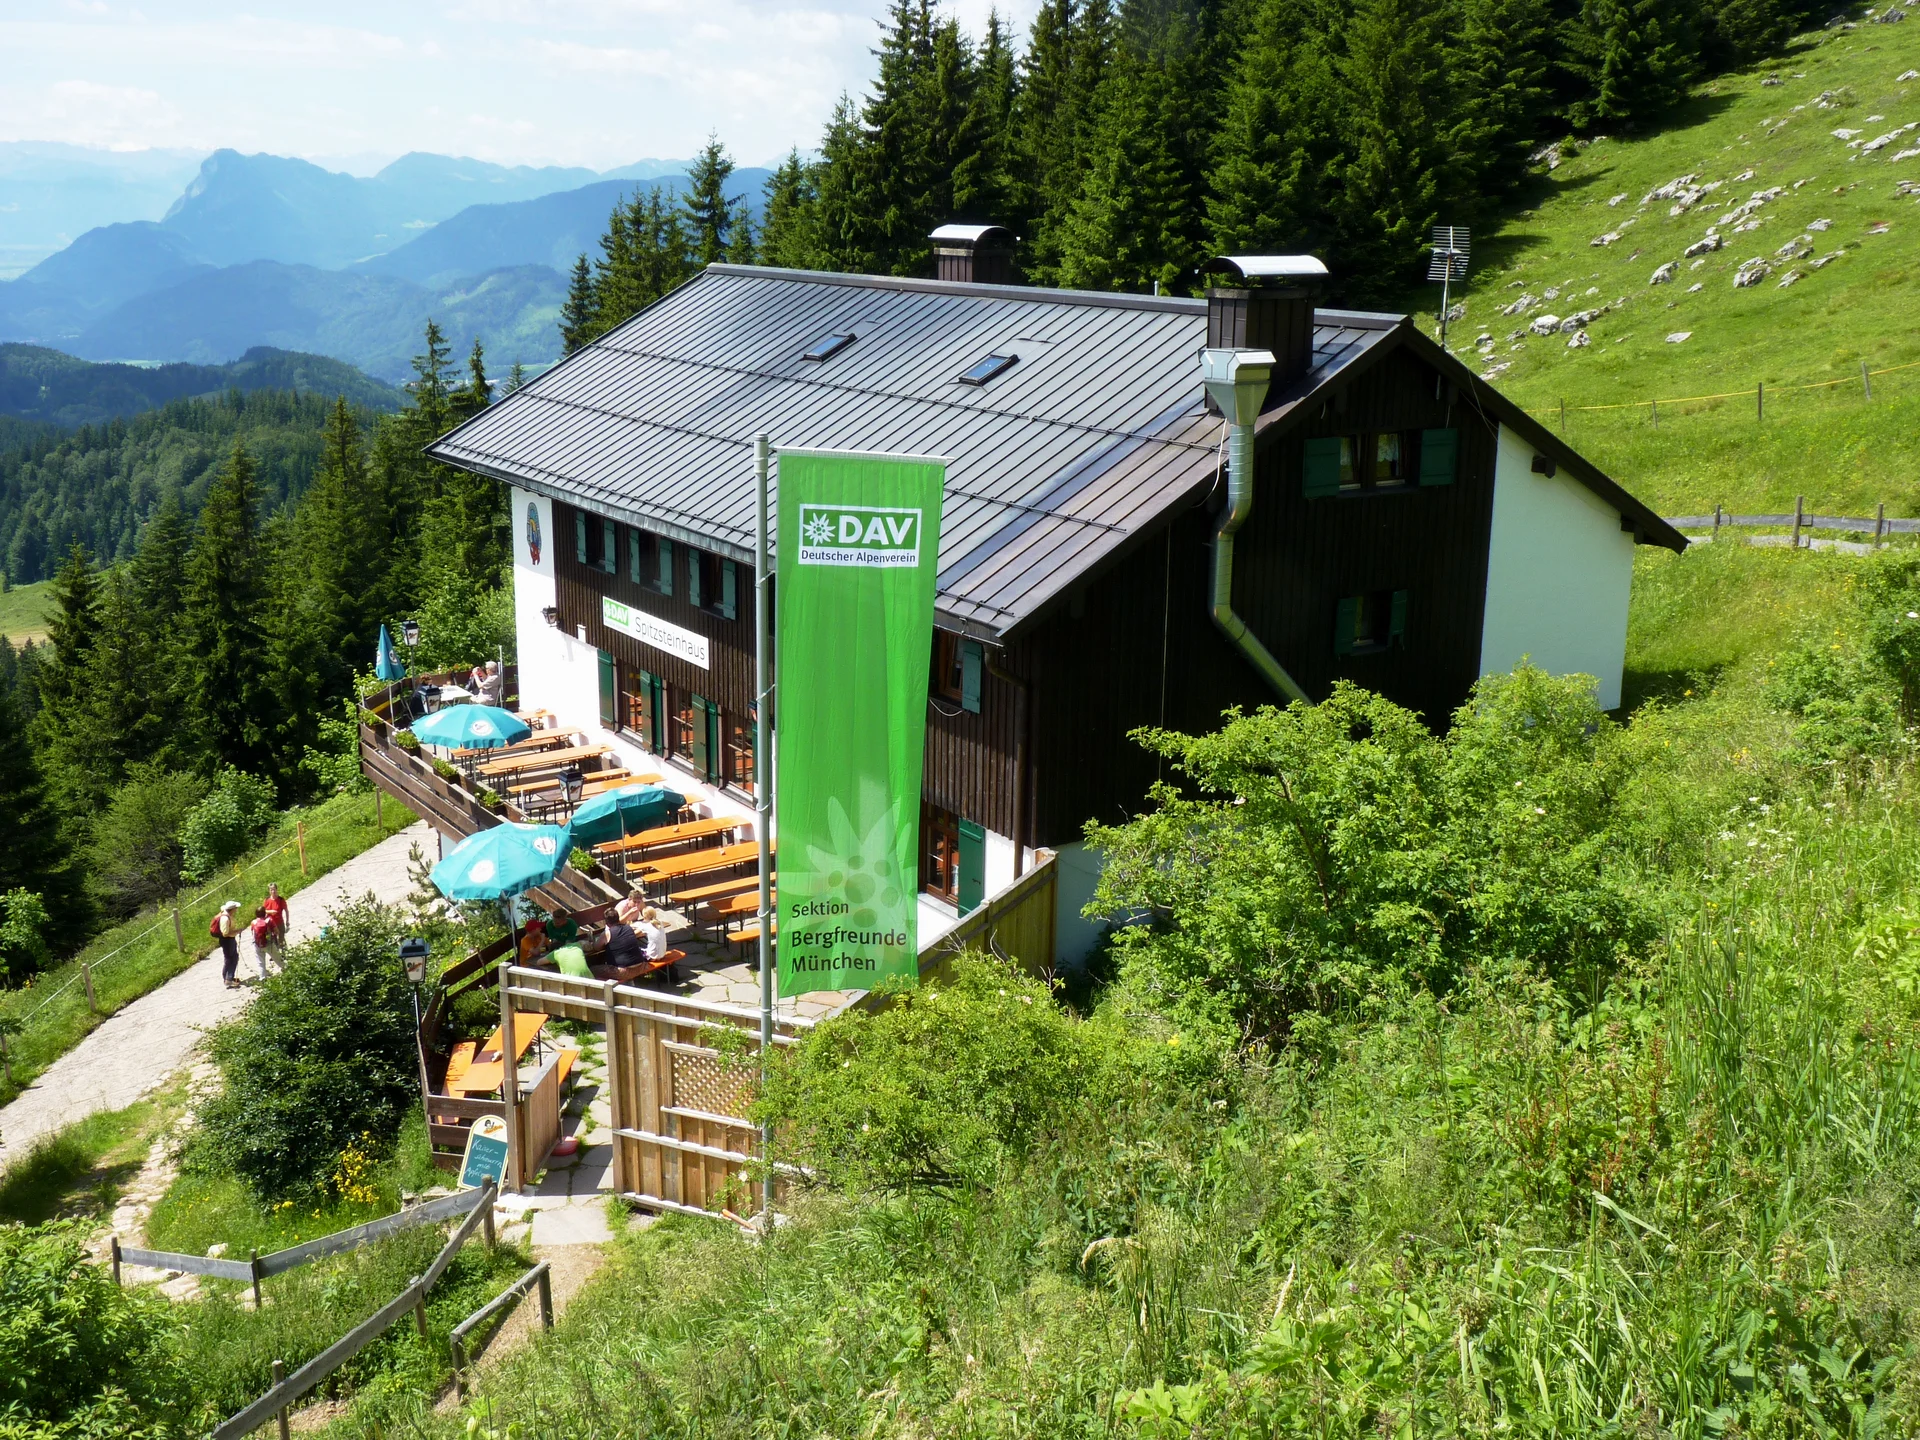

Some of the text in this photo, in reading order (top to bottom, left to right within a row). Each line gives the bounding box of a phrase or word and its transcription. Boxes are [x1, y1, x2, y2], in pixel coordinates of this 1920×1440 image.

[838, 515, 914, 545] DAV
[801, 550, 916, 564] Deutscher Alpenverein
[611, 604, 628, 624] DAV
[635, 616, 705, 660] Spitzsteinhaus
[791, 901, 849, 918] Sektion
[791, 926, 907, 949] Bergfreunde
[791, 952, 876, 974] München
